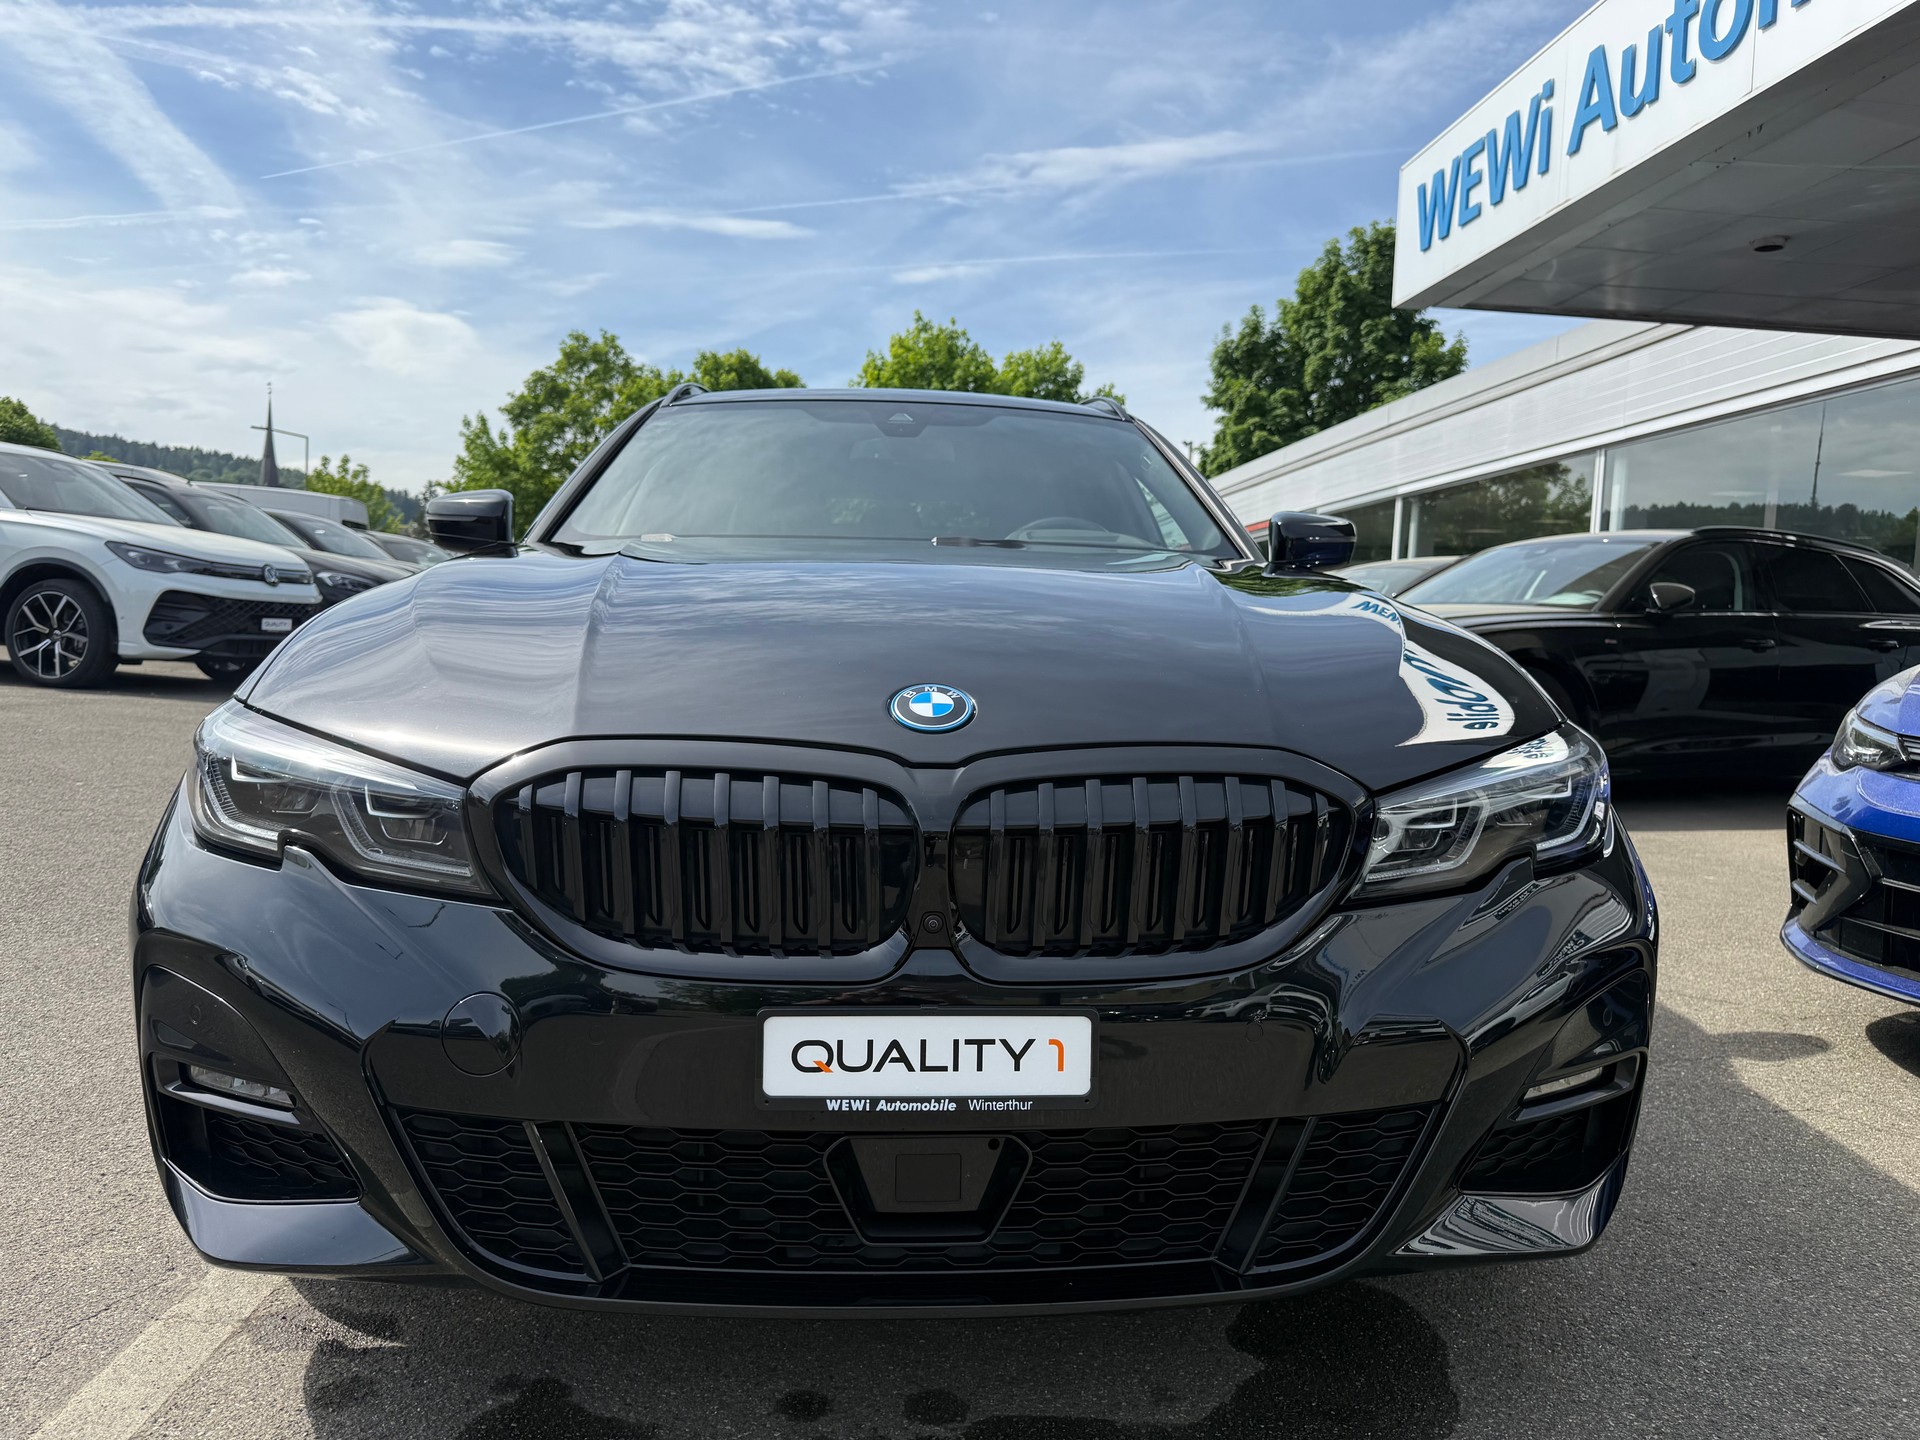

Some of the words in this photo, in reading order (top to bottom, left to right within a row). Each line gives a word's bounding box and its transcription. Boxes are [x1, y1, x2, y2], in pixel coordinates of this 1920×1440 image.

[1417, 79, 1554, 253] WEWi
[1567, 0, 1811, 156] Auto
[903, 686, 960, 699] BMW
[791, 1039, 1036, 1073] QUALITY
[1048, 1038, 1064, 1072] 1
[826, 1099, 870, 1111] WEWi
[876, 1099, 957, 1112] Automobile
[968, 1099, 1033, 1111] Winterthur
